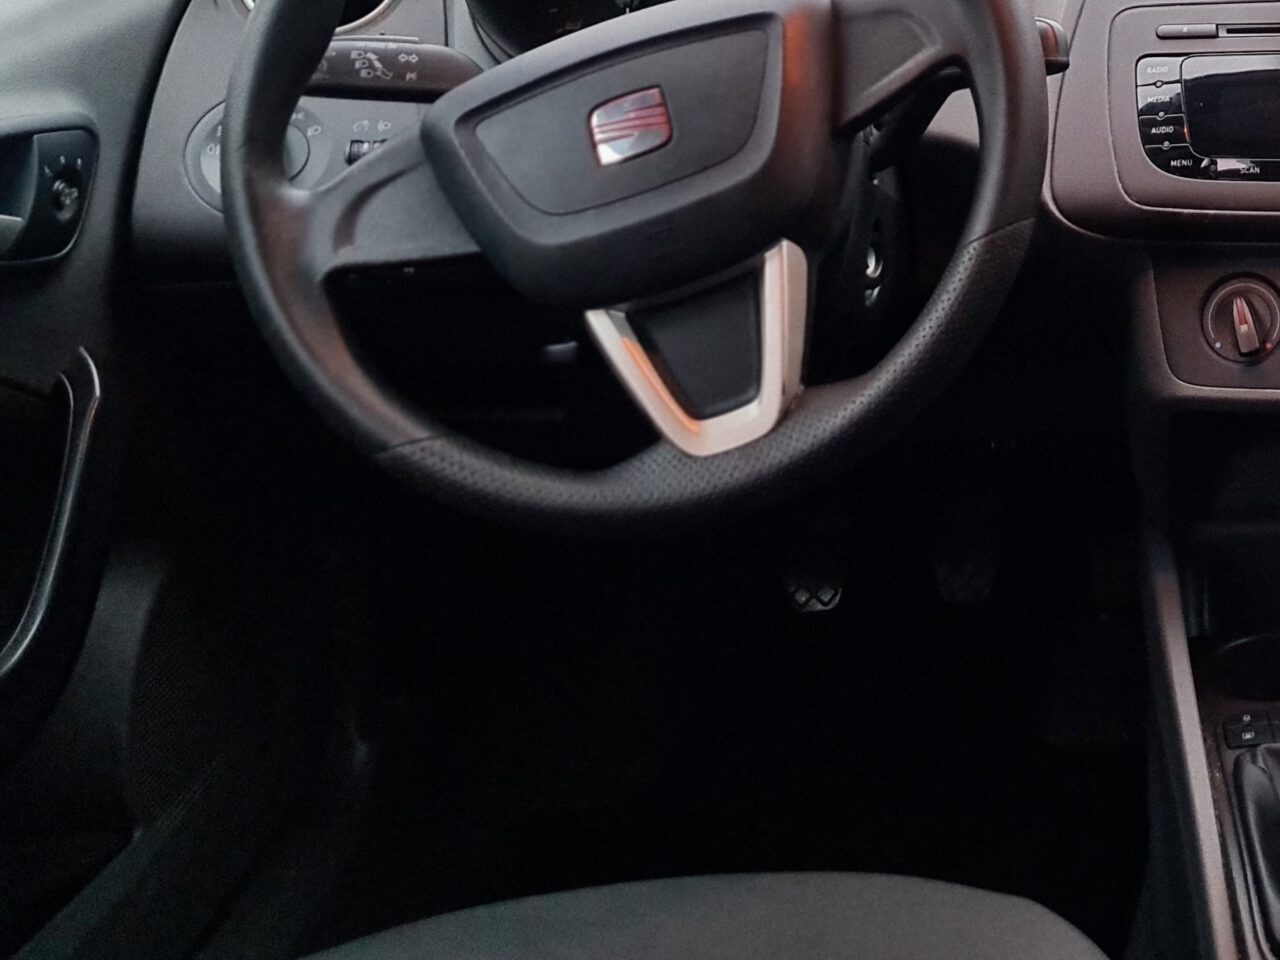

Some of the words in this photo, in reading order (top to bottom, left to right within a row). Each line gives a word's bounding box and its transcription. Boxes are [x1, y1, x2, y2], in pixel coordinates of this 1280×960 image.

[1146, 65, 1169, 73] RADIO
[1147, 95, 1170, 103] MEDIA
[1151, 126, 1174, 134] AUDIO
[1170, 159, 1193, 167] MENU
[1240, 166, 1260, 174] SCAN
